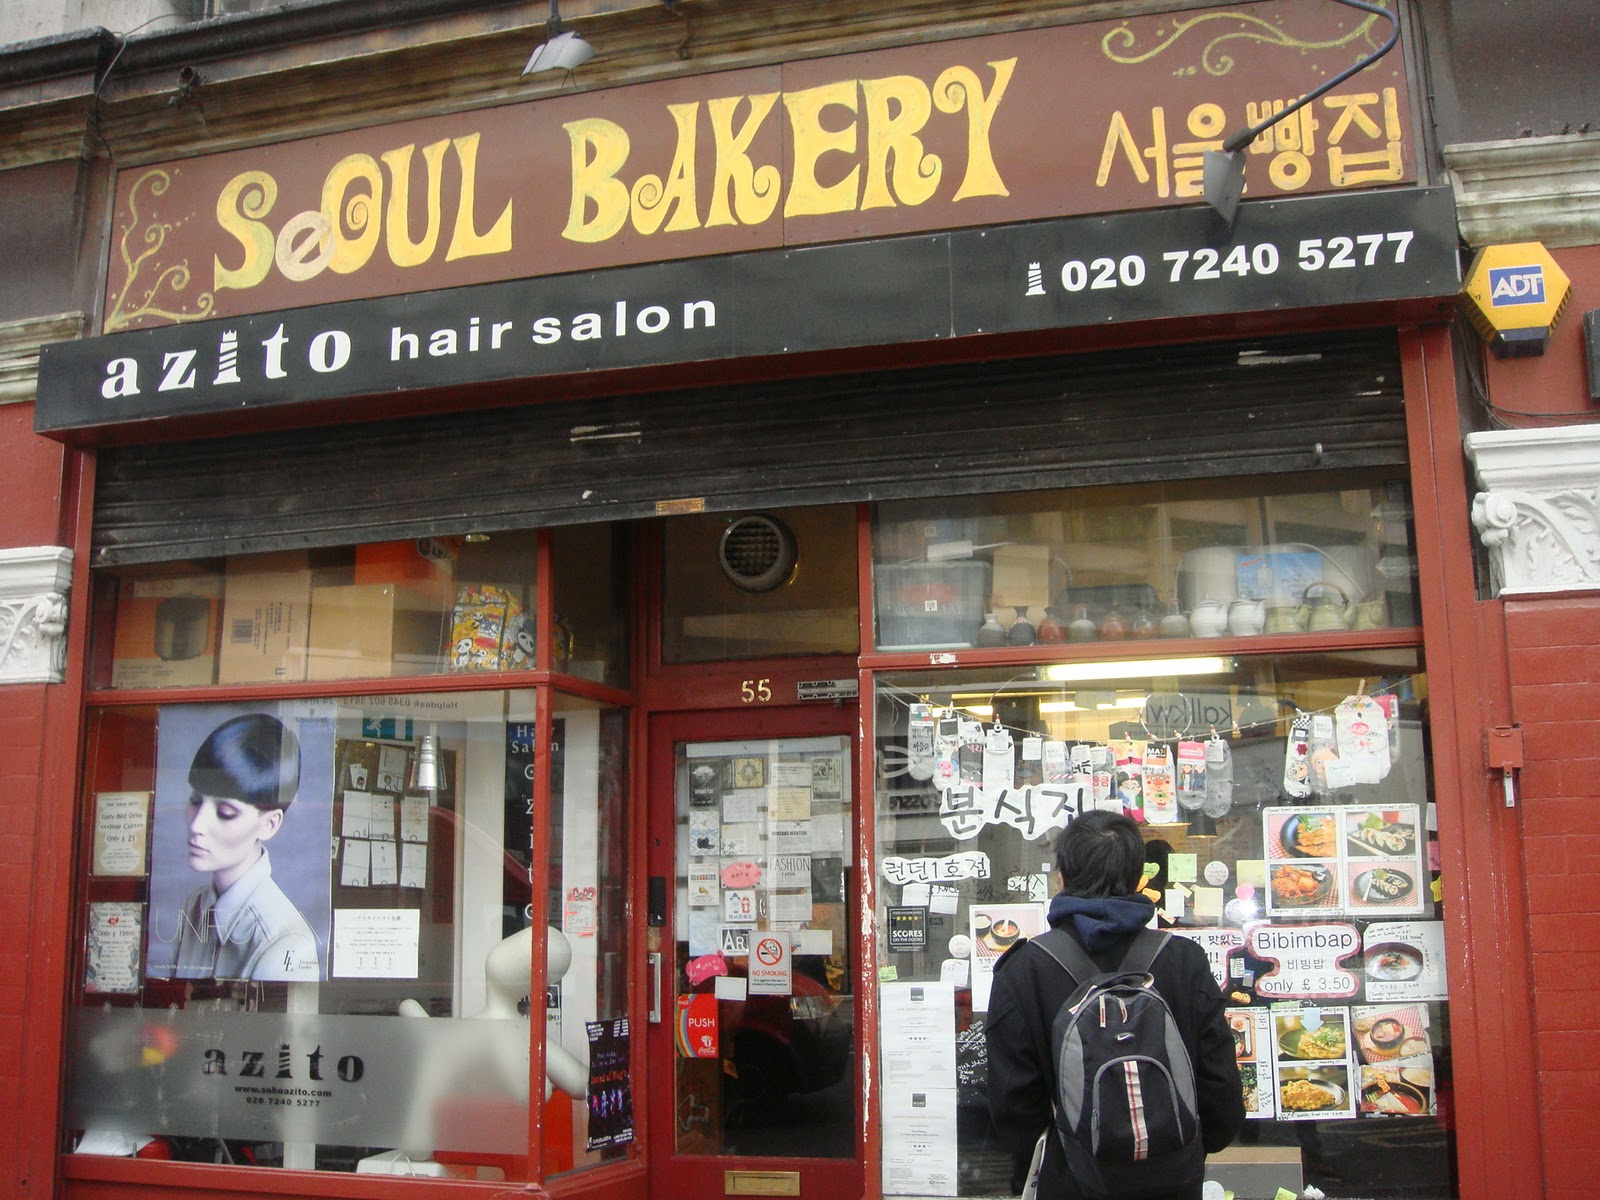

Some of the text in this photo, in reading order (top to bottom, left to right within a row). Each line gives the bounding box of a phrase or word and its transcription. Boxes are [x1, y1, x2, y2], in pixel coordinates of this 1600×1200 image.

[561, 57, 1017, 243] BAKERY
[1061, 231, 1415, 293] 020 7240 5277
[1492, 273, 1542, 299] ADT
[101, 300, 717, 399] azito hair salon
[741, 678, 772, 703] 55
[512, 740, 559, 754] Saln
[769, 857, 810, 872] FASHION
[892, 930, 923, 938] SCORES
[1258, 931, 1353, 950] Bibimbap
[1264, 976, 1350, 993] only £ 3.50
[689, 1018, 714, 1027] PUSH
[202, 1043, 364, 1082] azito
[234, 1085, 332, 1097] www.sohoazito.com
[246, 1096, 320, 1107] 020 7240 5277
